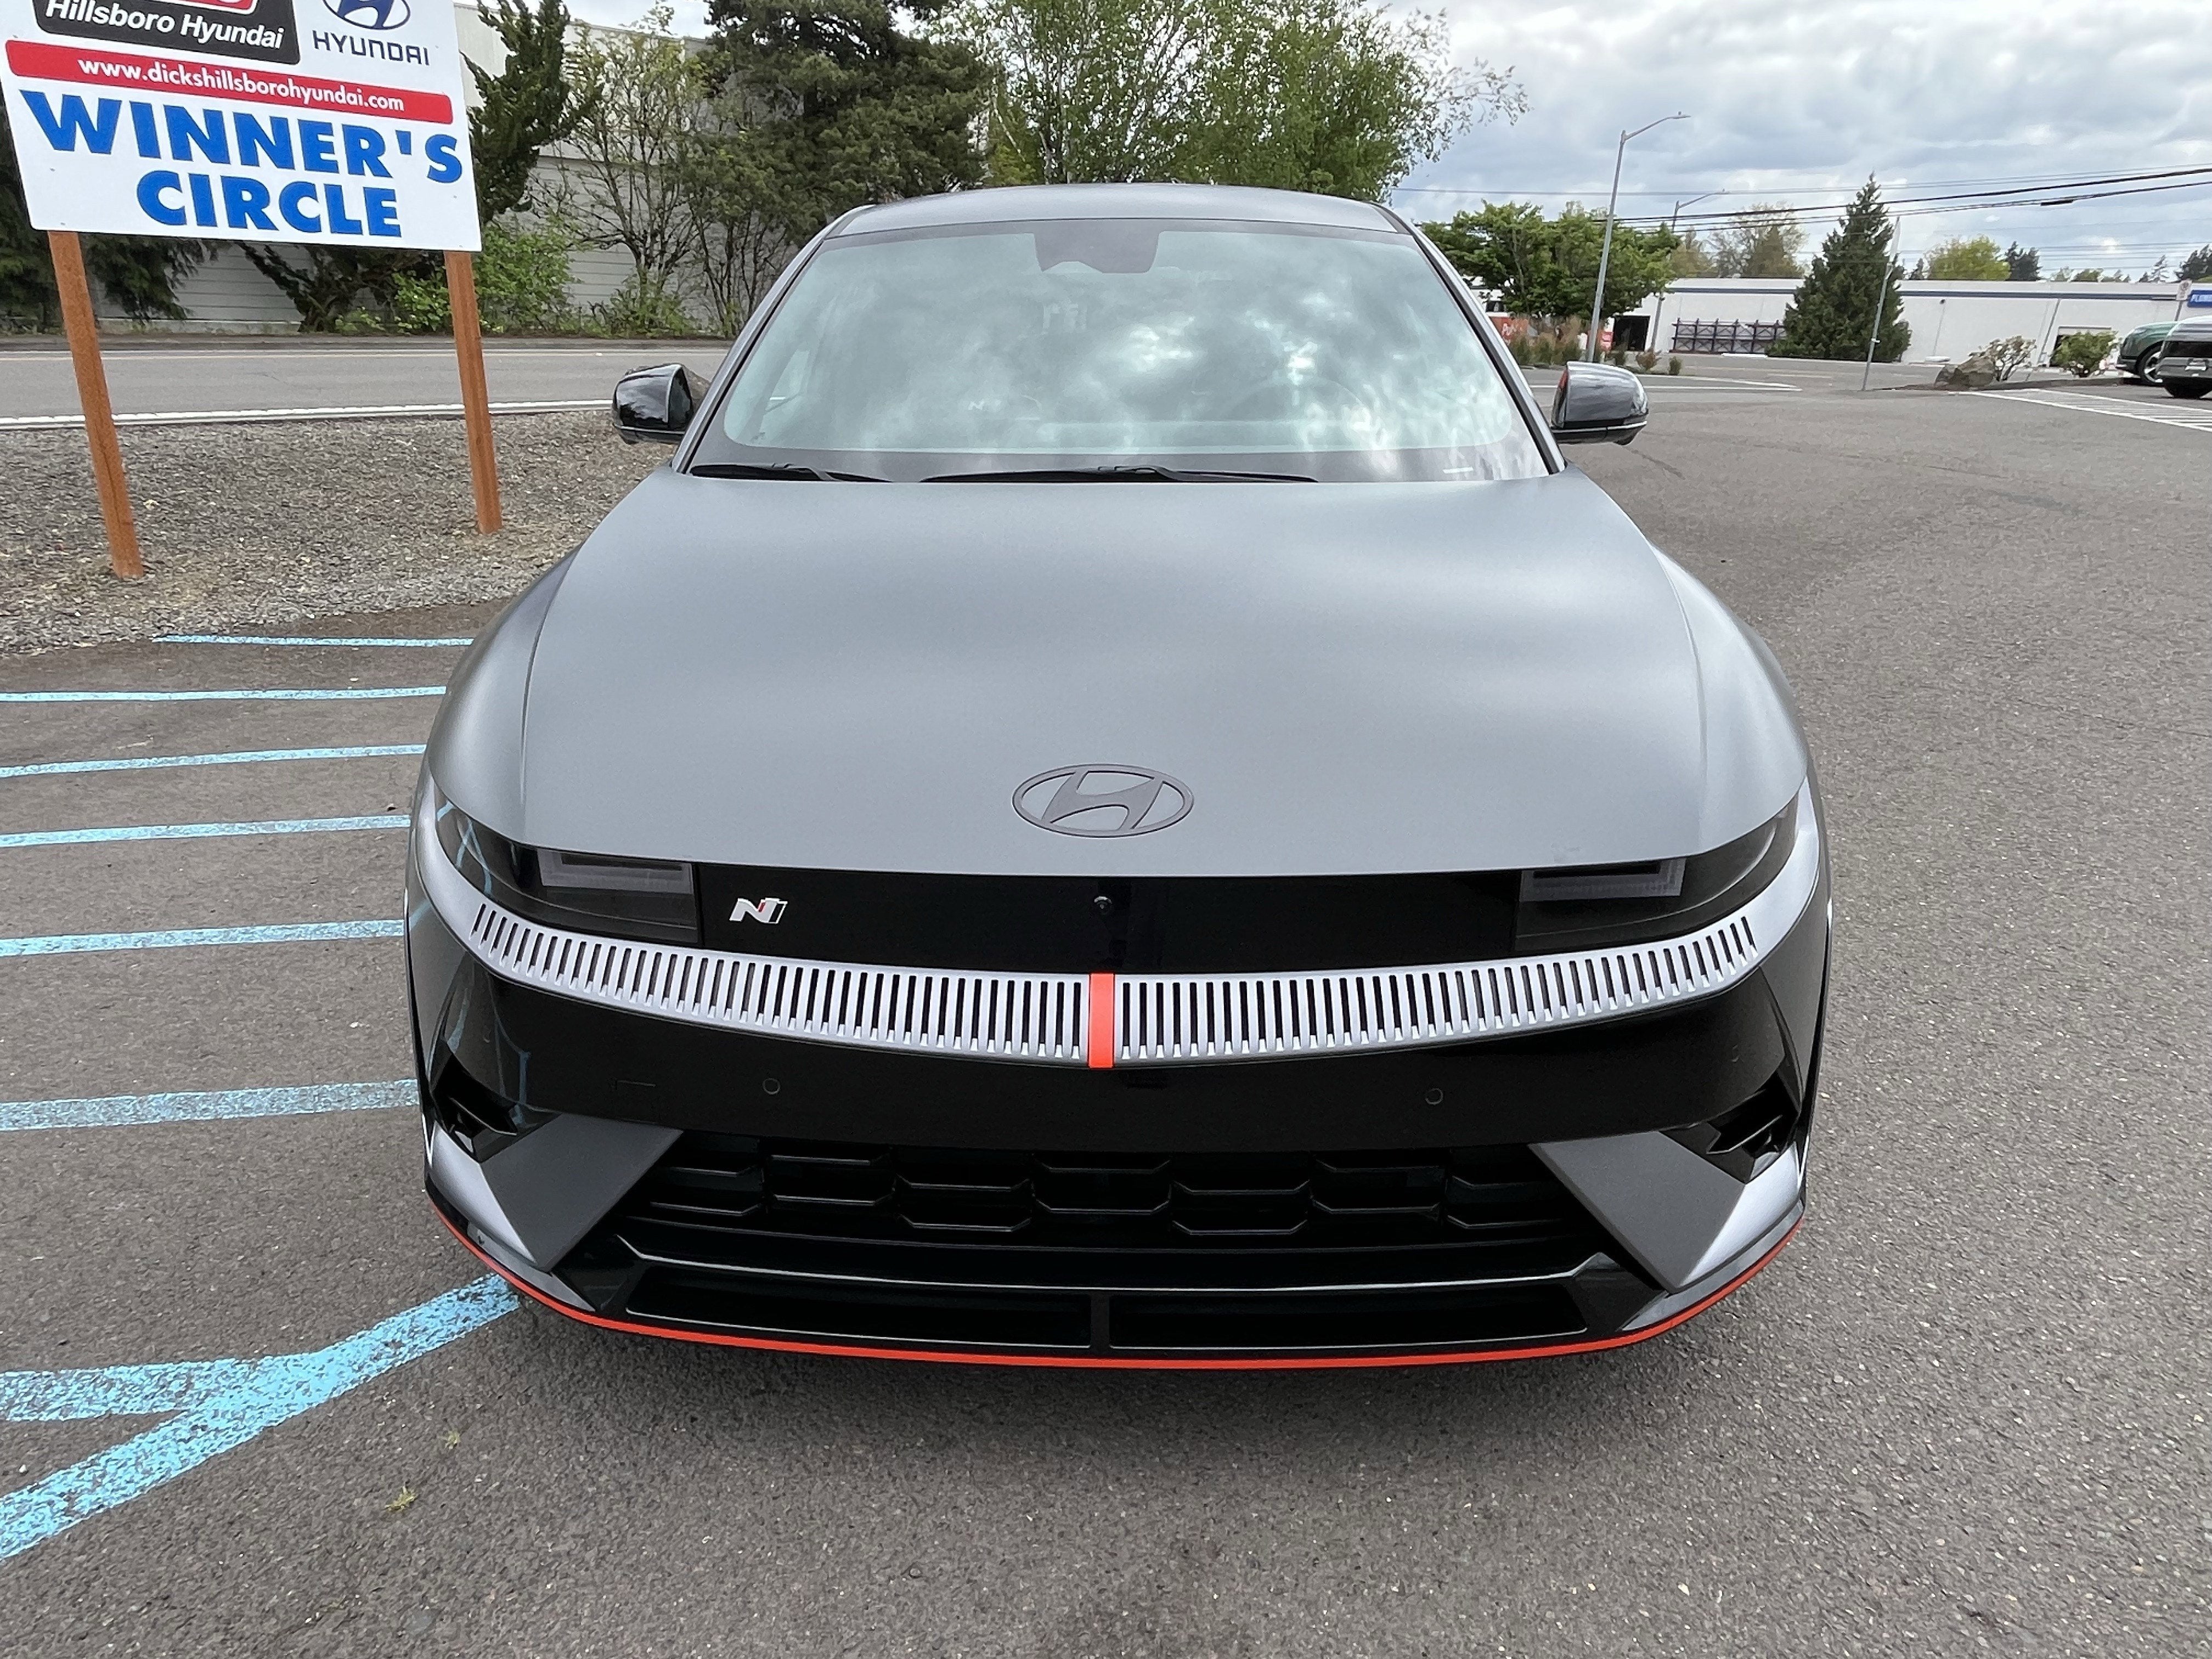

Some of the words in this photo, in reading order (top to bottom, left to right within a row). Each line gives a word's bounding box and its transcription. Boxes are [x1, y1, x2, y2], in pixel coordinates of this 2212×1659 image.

[46, 0, 176, 33] Hillsboro
[180, 13, 284, 49] Hyundai
[312, 30, 430, 66] HYUNDAI
[77, 59, 405, 111] www.dickshillsborohyundai.com
[19, 89, 462, 184] WINNER'S
[137, 171, 402, 238] CIRCLE
